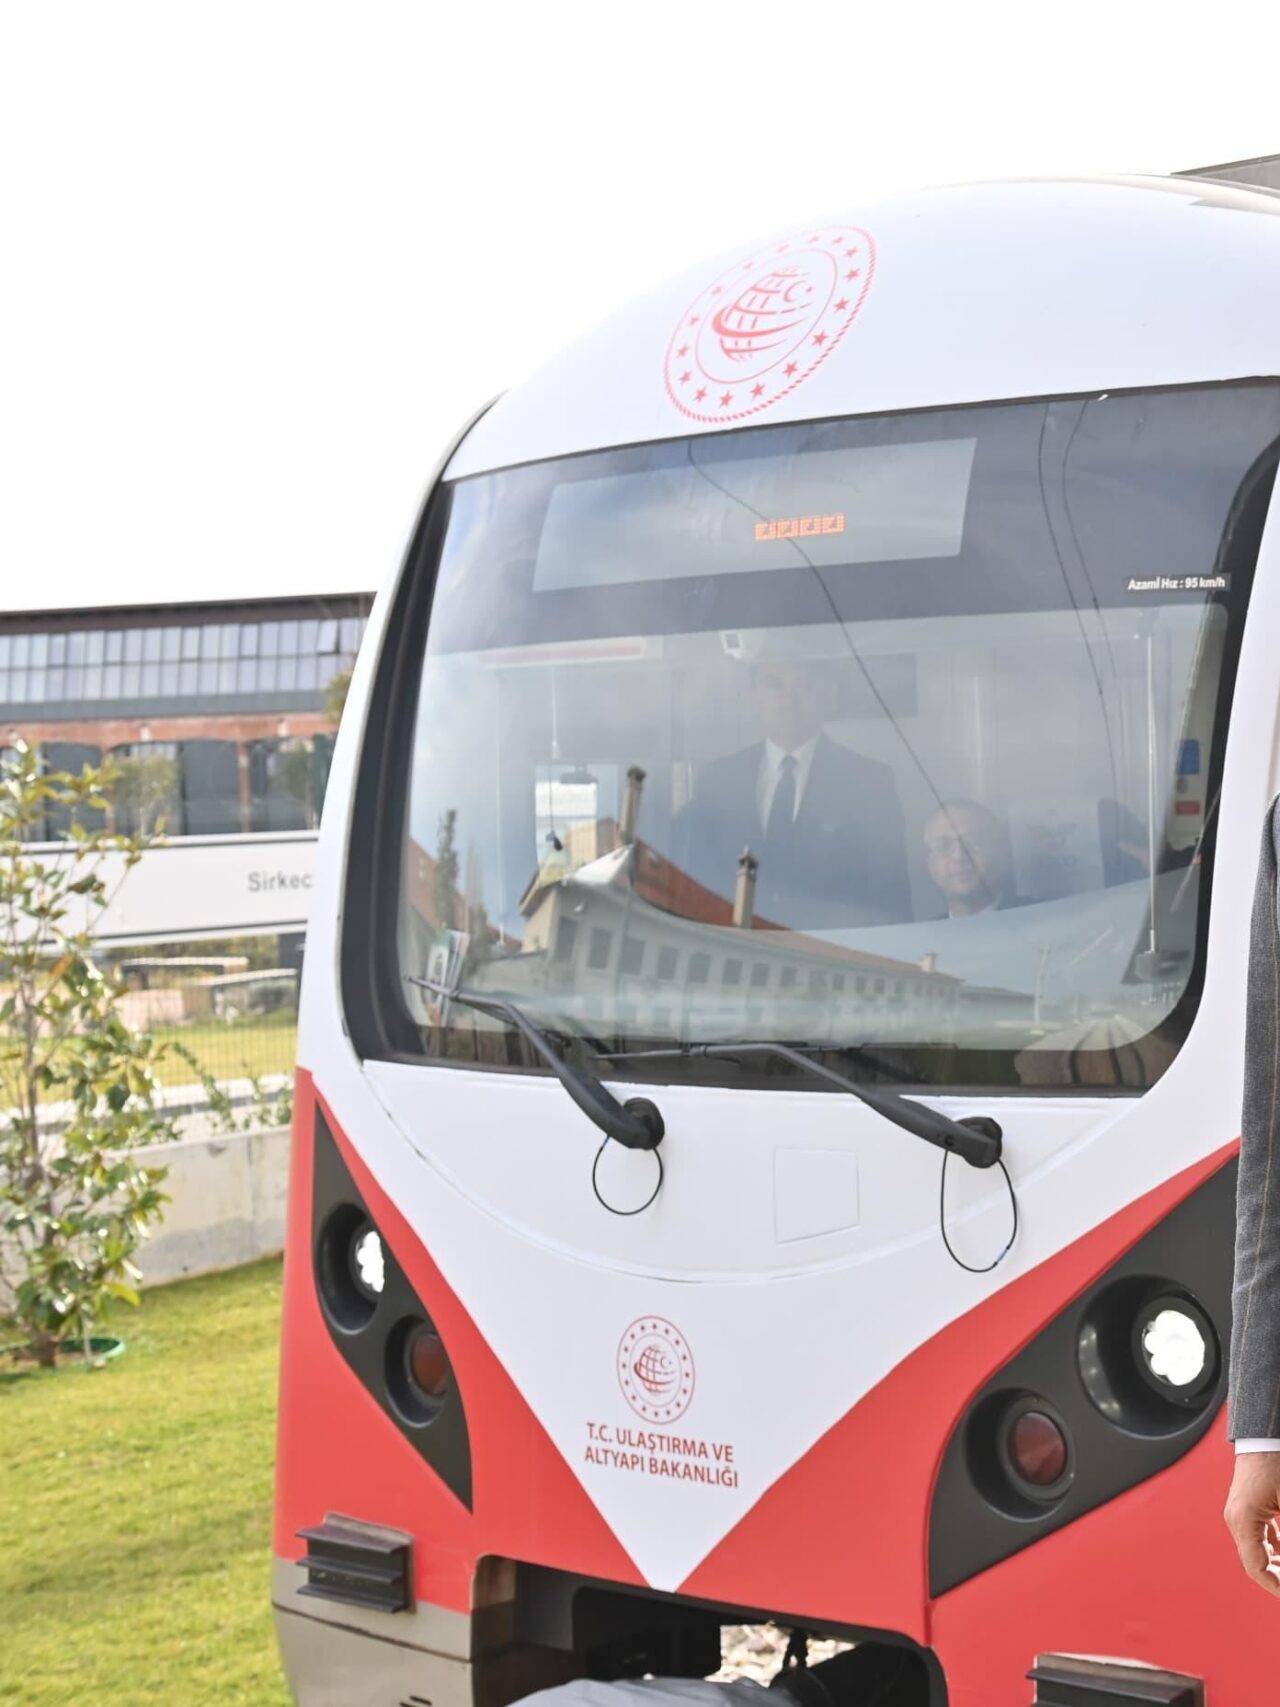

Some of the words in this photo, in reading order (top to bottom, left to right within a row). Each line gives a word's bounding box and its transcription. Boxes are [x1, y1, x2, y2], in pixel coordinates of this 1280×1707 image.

[1184, 577, 1198, 588] 95
[1199, 577, 1225, 588] km/h
[586, 1422, 613, 1443] T.C.
[615, 1427, 709, 1459] ULAŞTIRMA
[711, 1442, 735, 1463] VE
[584, 1446, 645, 1472] ALTYAPI
[648, 1456, 739, 1488] BAKANLIĞI
